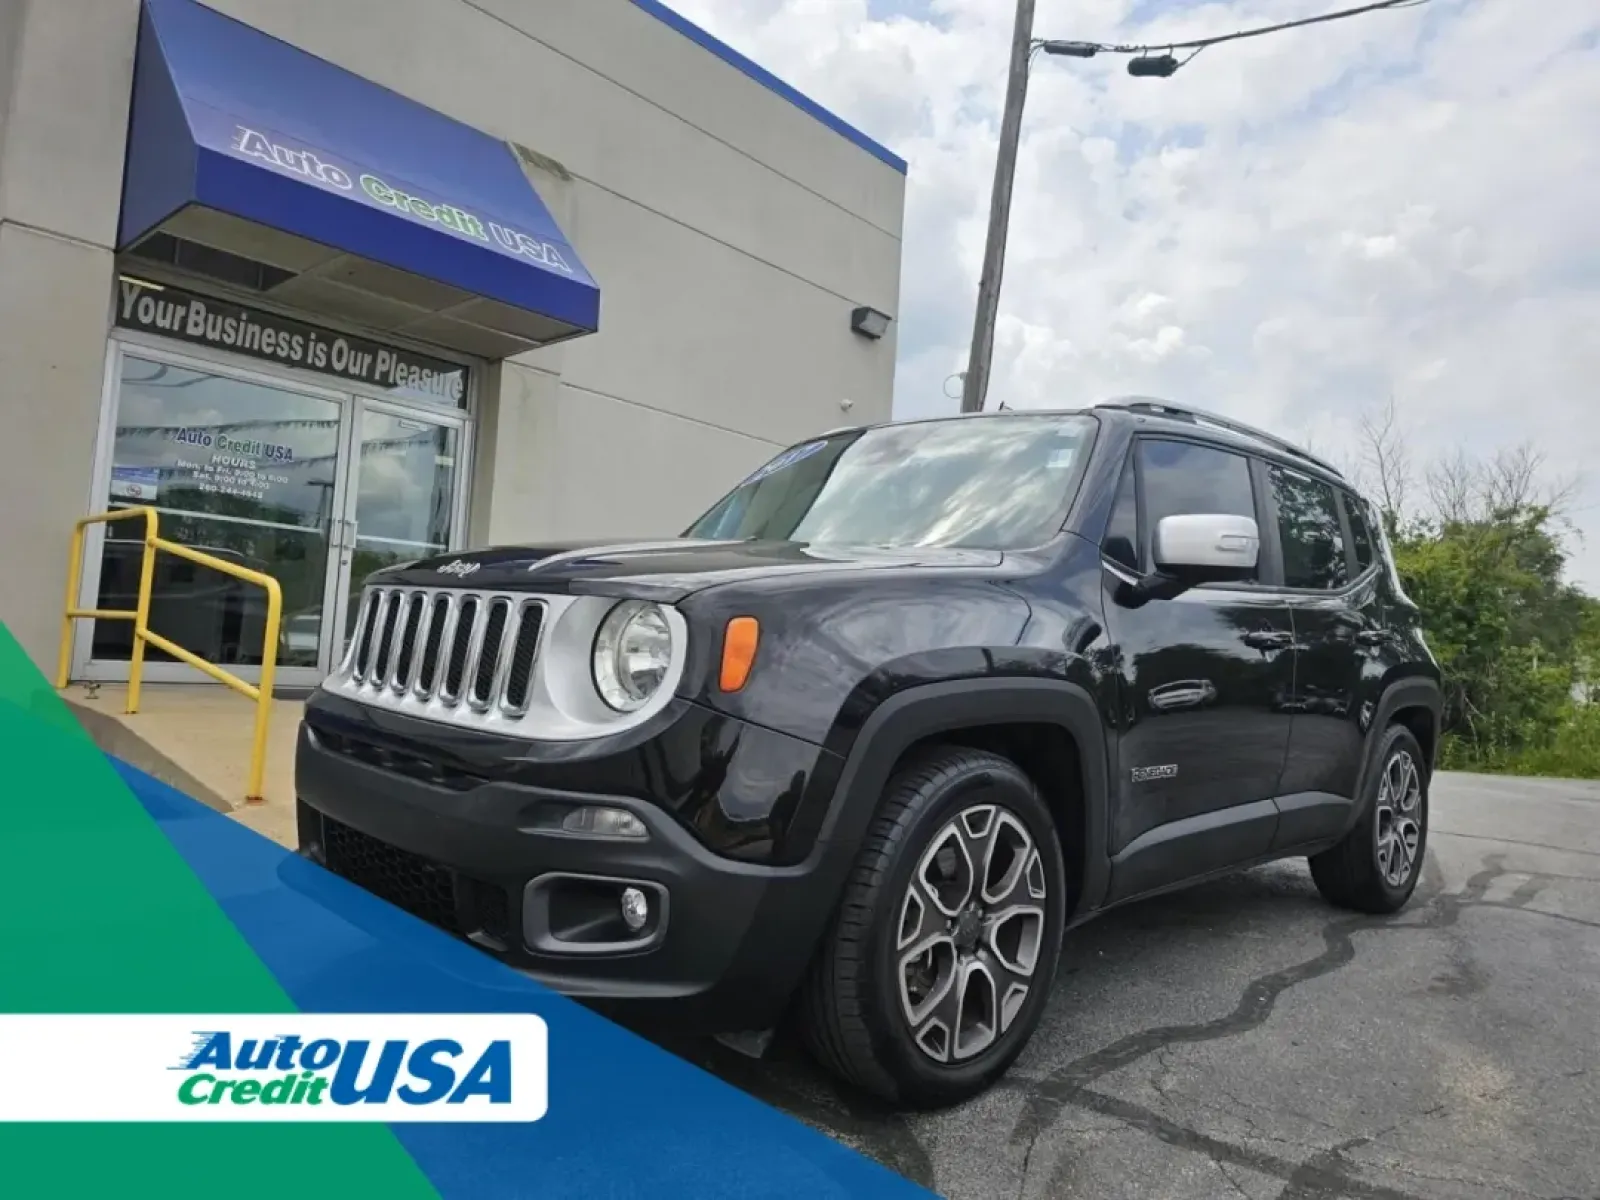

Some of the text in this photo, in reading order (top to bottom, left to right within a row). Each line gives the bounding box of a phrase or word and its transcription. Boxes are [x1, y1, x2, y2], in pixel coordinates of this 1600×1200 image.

[232, 126, 573, 273] Auto Credit USA
[119, 282, 464, 401] Your Business is Our Pleasure
[177, 427, 294, 461] Auto Credit USA
[212, 455, 256, 469] HOURS
